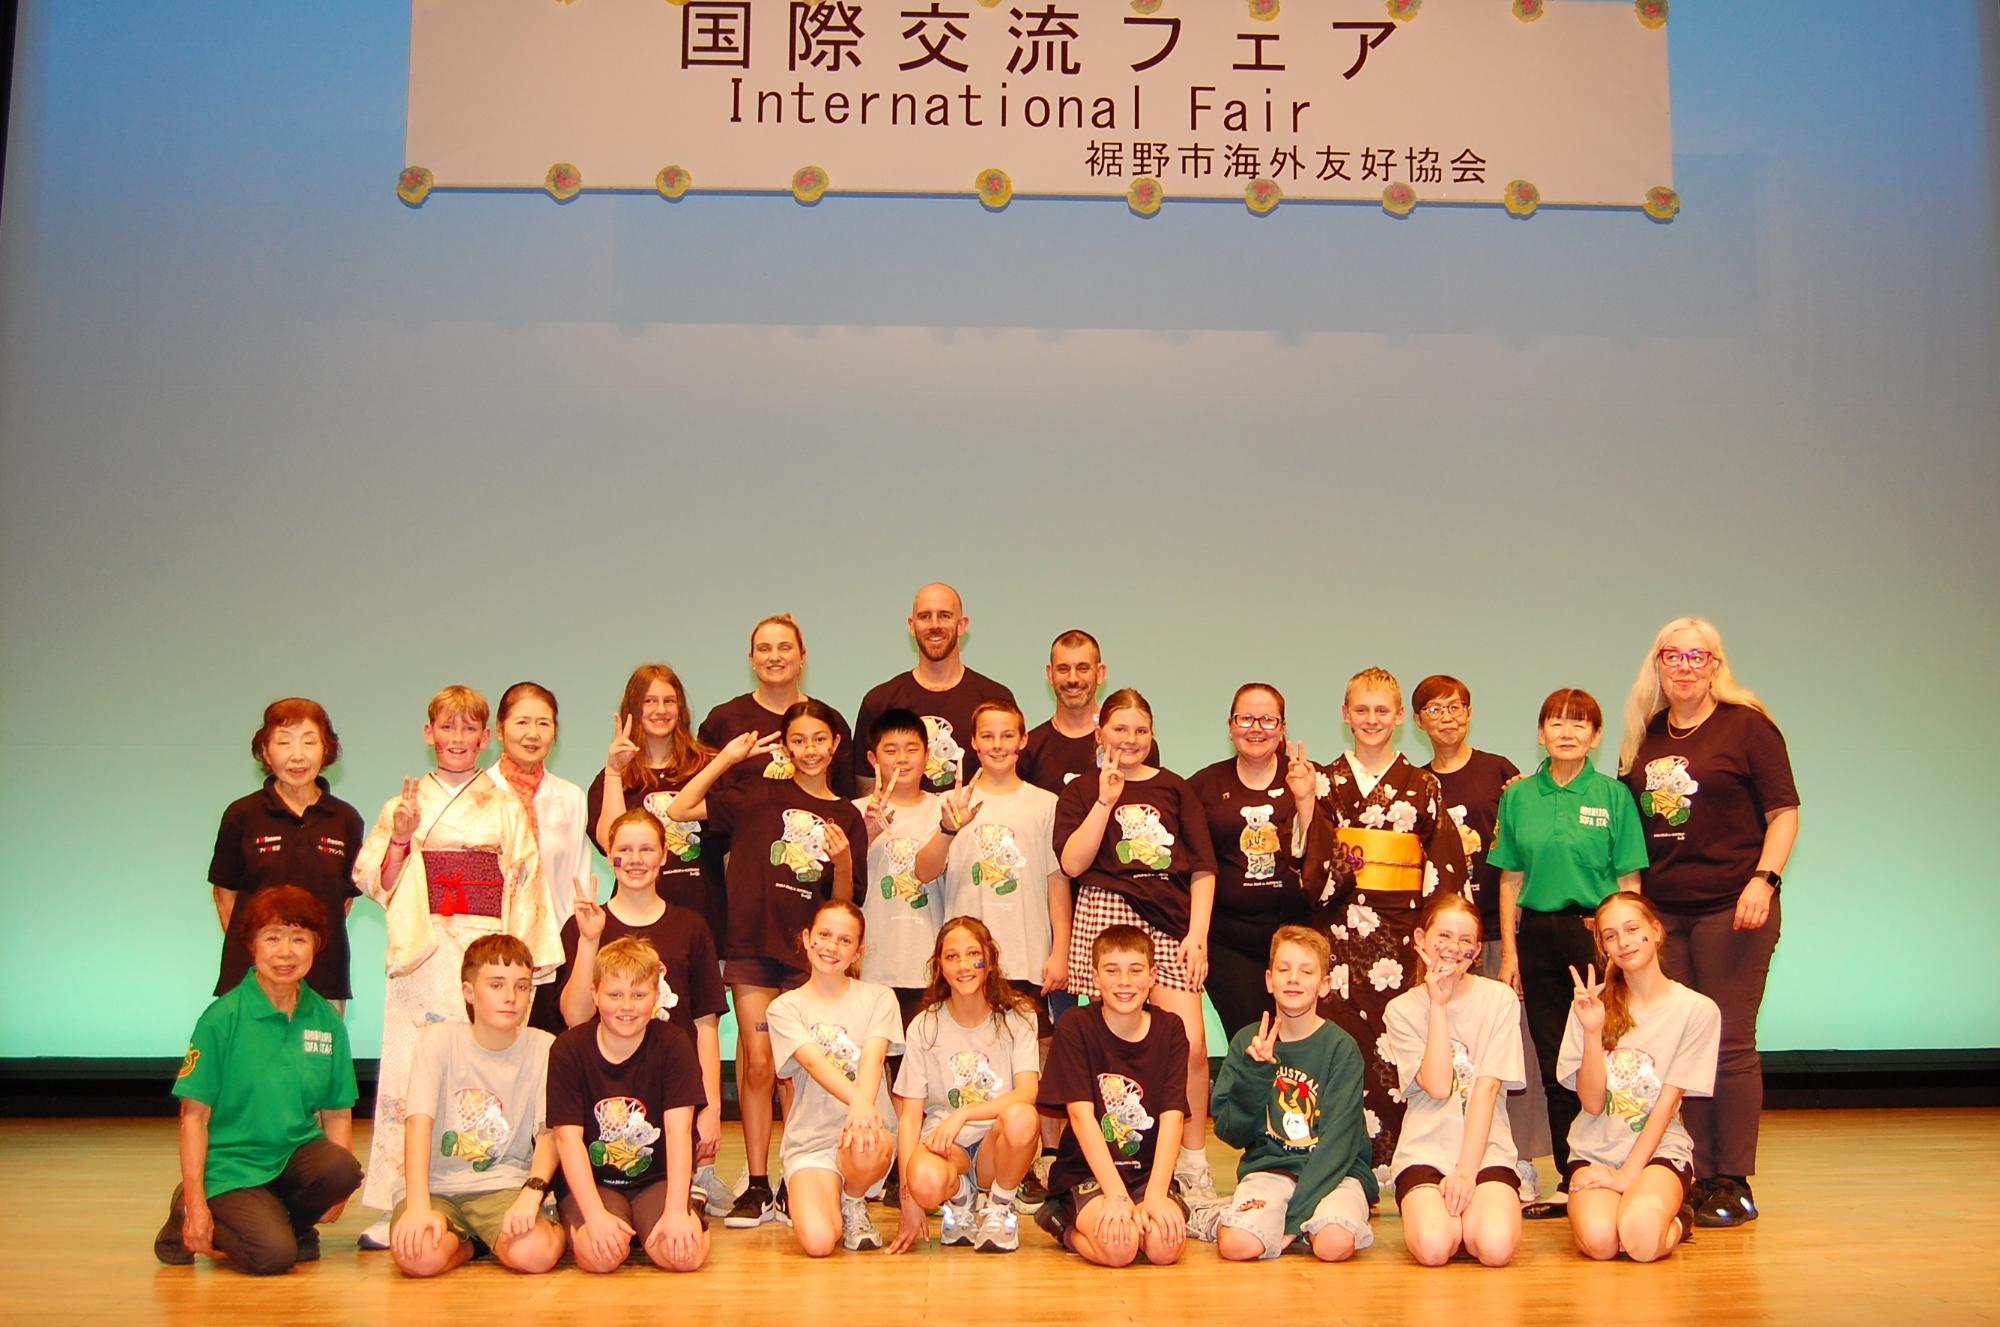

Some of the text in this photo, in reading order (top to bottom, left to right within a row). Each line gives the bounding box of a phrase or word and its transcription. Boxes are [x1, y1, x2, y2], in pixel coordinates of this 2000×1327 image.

[682, 1, 1397, 80] 国際交流フェア
[731, 78, 1310, 133] International Fair
[1085, 140, 1486, 184] 裾野市海外友好協会
[1275, 1066, 1319, 1097] USTRAL
